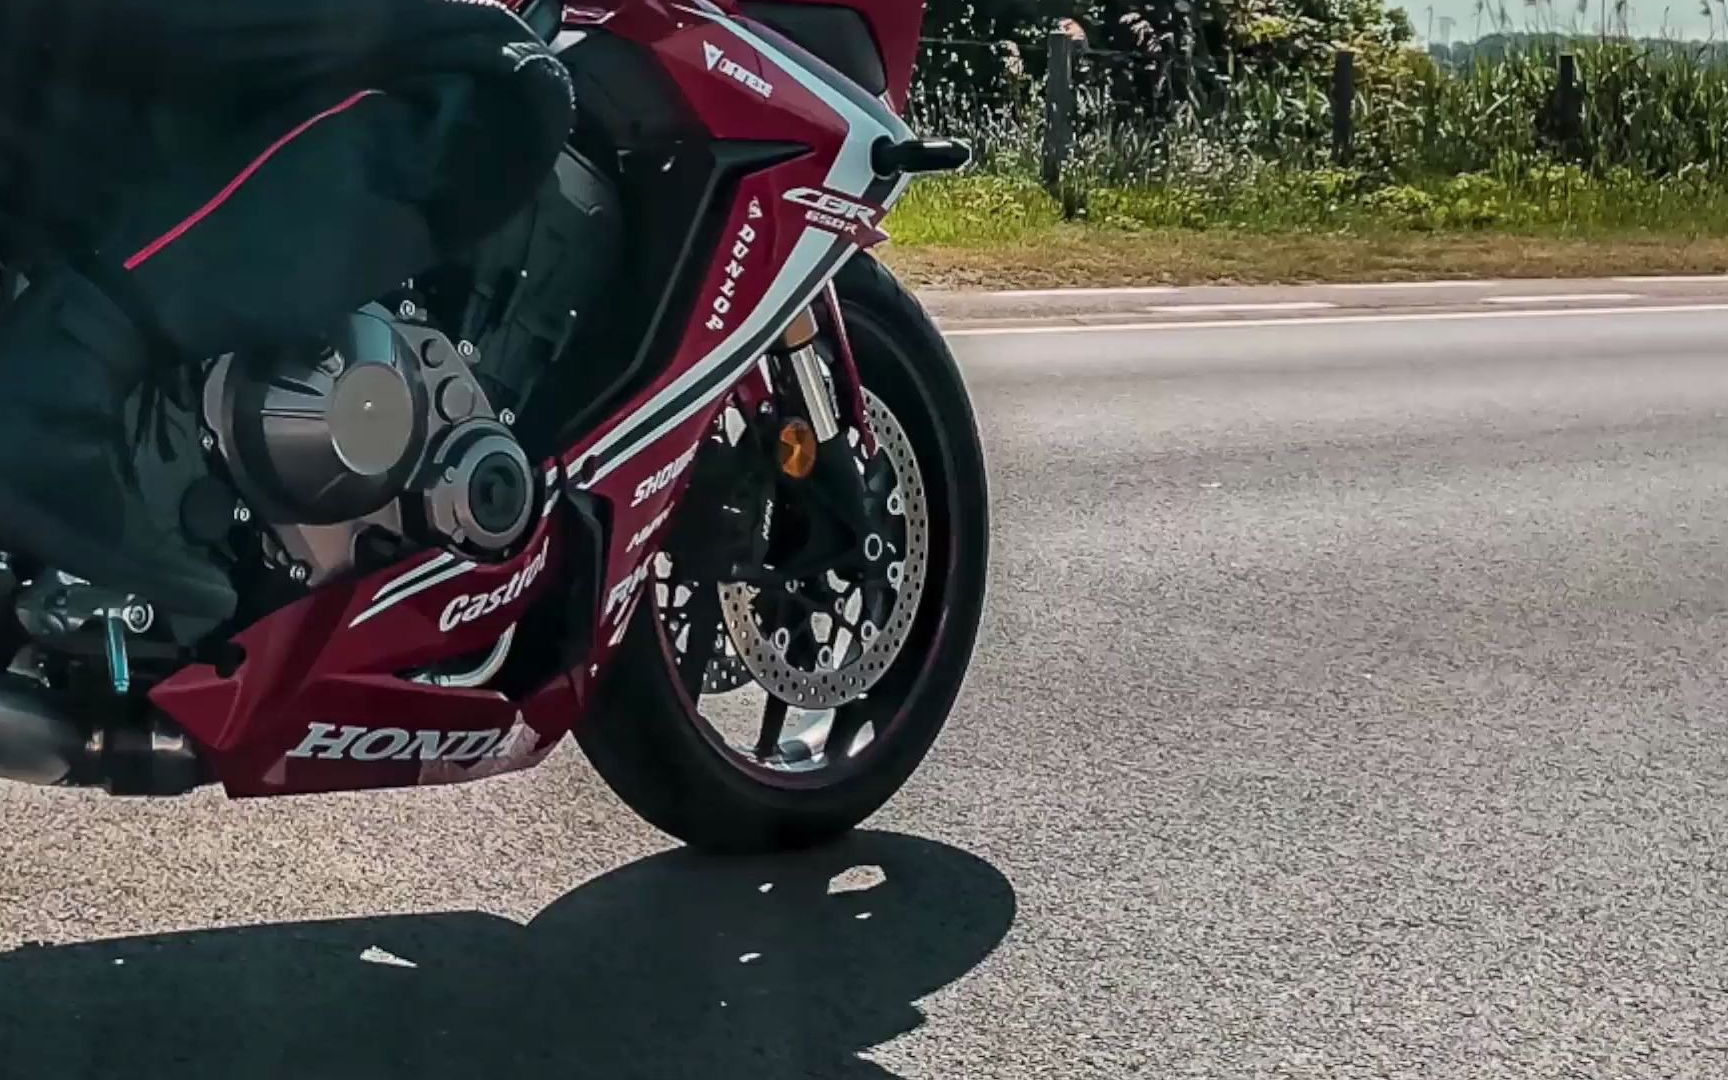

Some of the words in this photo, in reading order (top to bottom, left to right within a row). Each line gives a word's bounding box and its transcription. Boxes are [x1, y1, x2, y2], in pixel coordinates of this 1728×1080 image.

[782, 187, 877, 230] CBR
[439, 535, 550, 632] Castrol
[285, 721, 515, 761] HONDA
